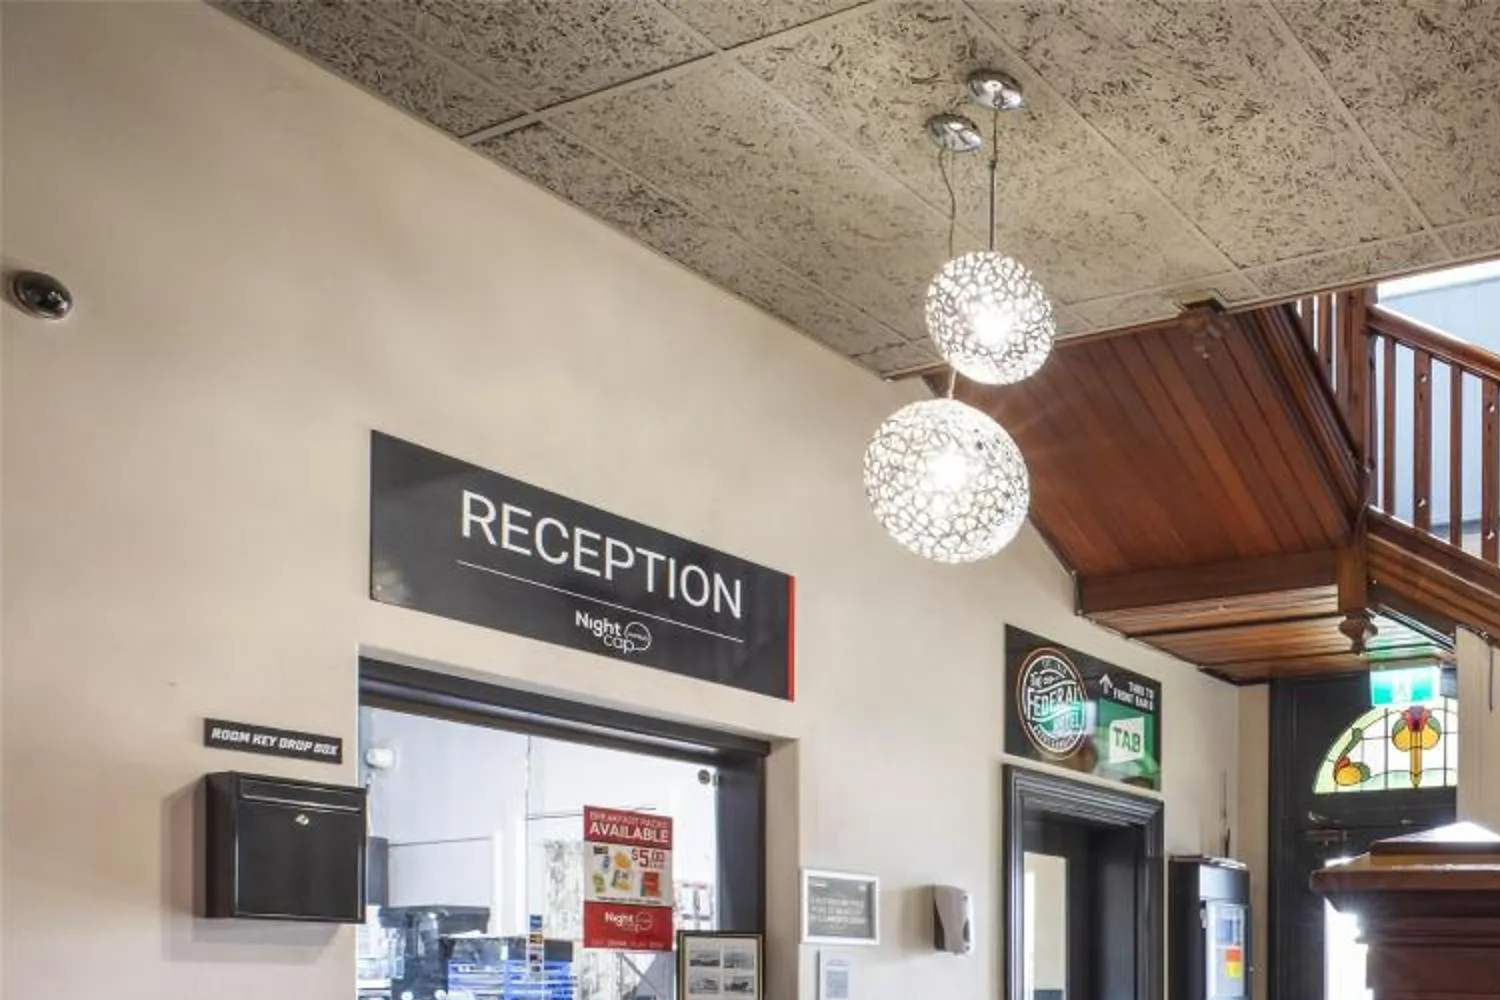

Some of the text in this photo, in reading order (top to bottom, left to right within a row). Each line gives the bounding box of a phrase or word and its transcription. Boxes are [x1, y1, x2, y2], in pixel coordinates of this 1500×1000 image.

[461, 489, 742, 619] RECEPTION
[575, 609, 622, 637] Night
[603, 634, 635, 654] cap
[211, 727, 339, 755] ROOM KEY DROP BOX
[1113, 727, 1141, 753] TAB
[588, 820, 669, 843] AVAILABLE
